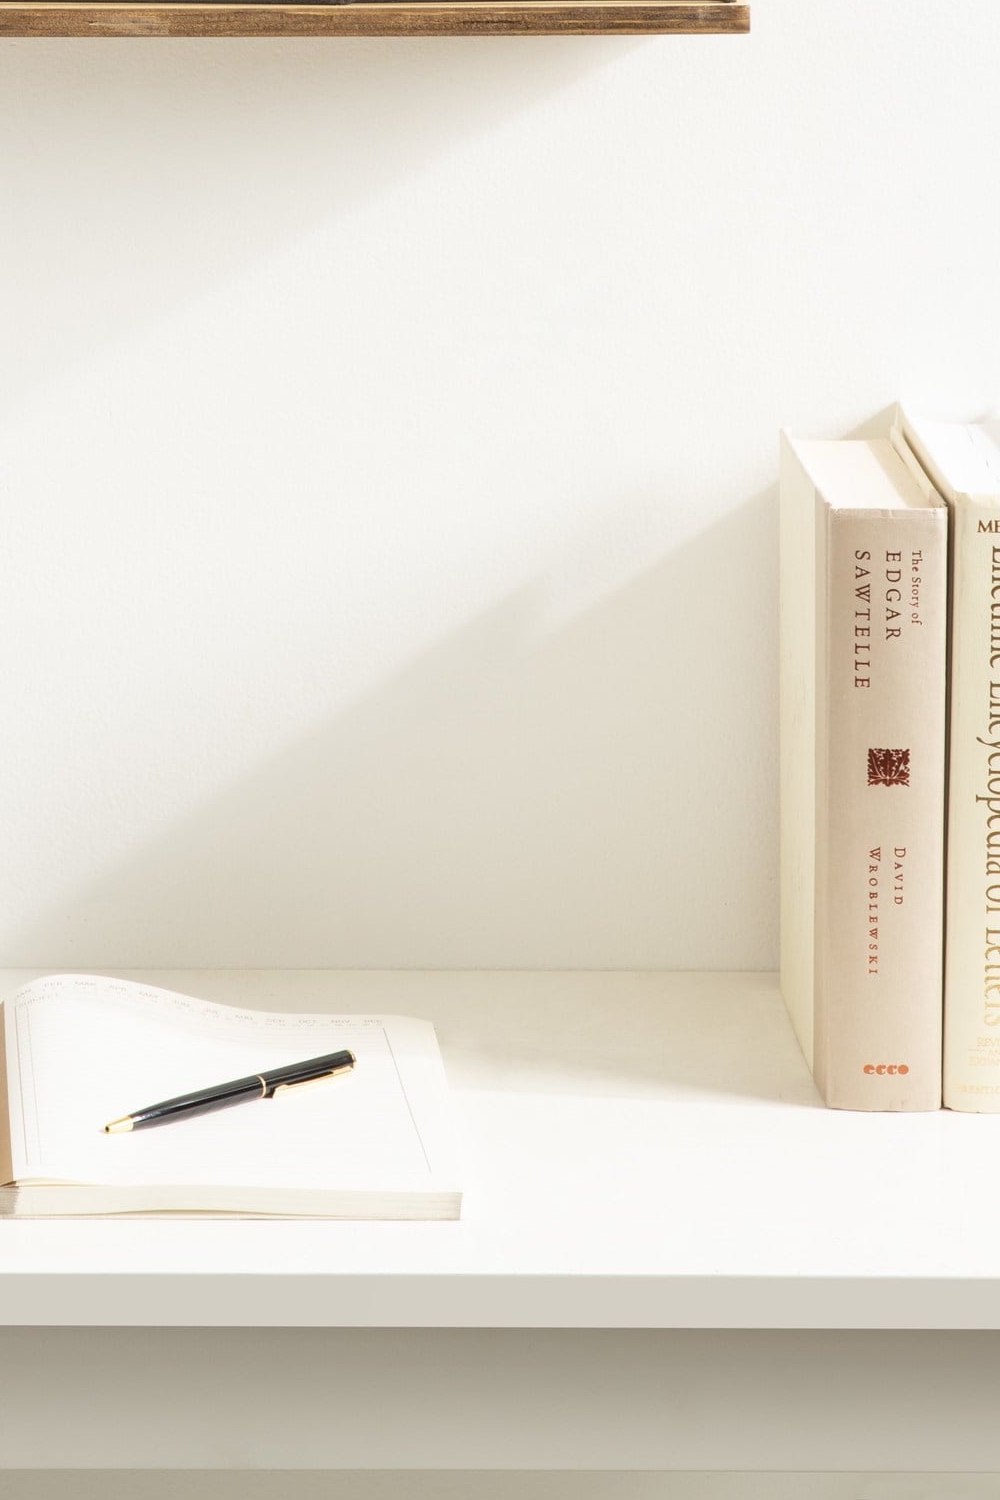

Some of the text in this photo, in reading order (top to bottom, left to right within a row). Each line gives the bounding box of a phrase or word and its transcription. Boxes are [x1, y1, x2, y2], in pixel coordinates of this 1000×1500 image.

[854, 550, 871, 688] SAWTELLE
[885, 550, 901, 641] EDGAR
[909, 550, 923, 625] The Story of
[868, 846, 881, 974] WROBLEWSKI
[893, 847, 906, 905] DAVID
